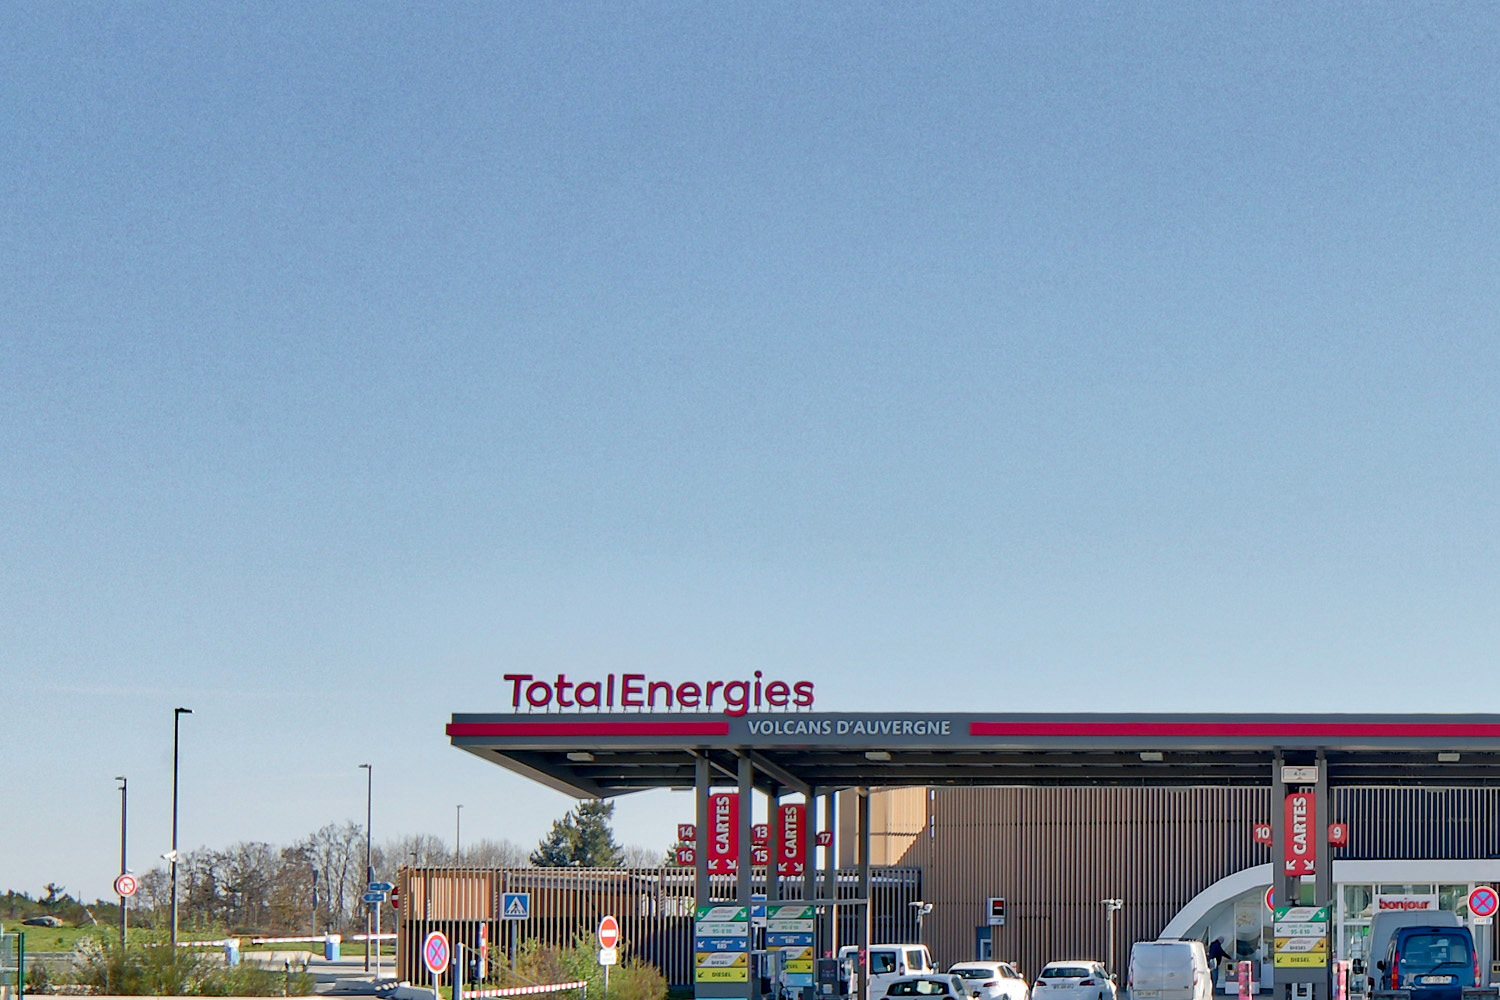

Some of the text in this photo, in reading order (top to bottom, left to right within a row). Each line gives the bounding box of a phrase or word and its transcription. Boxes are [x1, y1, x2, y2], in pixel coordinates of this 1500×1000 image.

[503, 671, 815, 717] TotalEnergies
[748, 720, 832, 735] VOLCANS
[716, 797, 729, 854] CARTES
[1293, 797, 1307, 855] CARTES
[680, 827, 693, 838] 14
[755, 827, 768, 838] 13
[785, 807, 797, 858] CARTES
[819, 833, 831, 844] 17
[1256, 827, 1270, 839] 10
[1333, 827, 1342, 839] 9
[680, 850, 693, 862] 16
[754, 850, 768, 862] 15
[1379, 898, 1430, 911] bonjour
